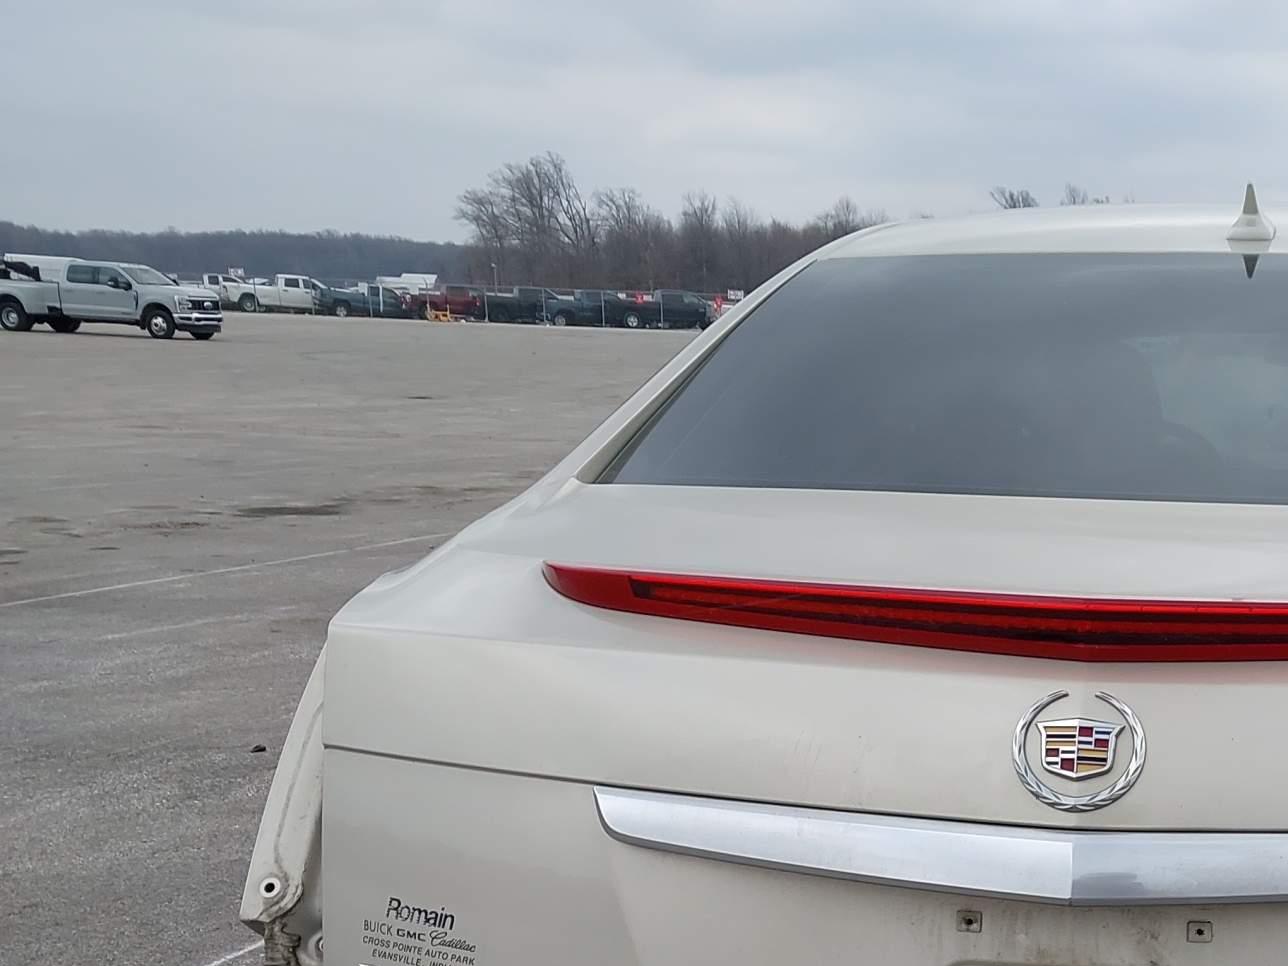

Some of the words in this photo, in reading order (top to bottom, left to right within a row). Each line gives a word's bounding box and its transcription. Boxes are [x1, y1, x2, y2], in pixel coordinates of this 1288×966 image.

[386, 896, 455, 931] Romain
[362, 935, 391, 949] CROSS
[392, 941, 423, 956] POINTE
[425, 948, 449, 961] AUTO
[450, 953, 476, 966] PARK
[363, 919, 393, 937] BUICK
[396, 928, 427, 942] GMC
[429, 930, 477, 953] Cadillac
